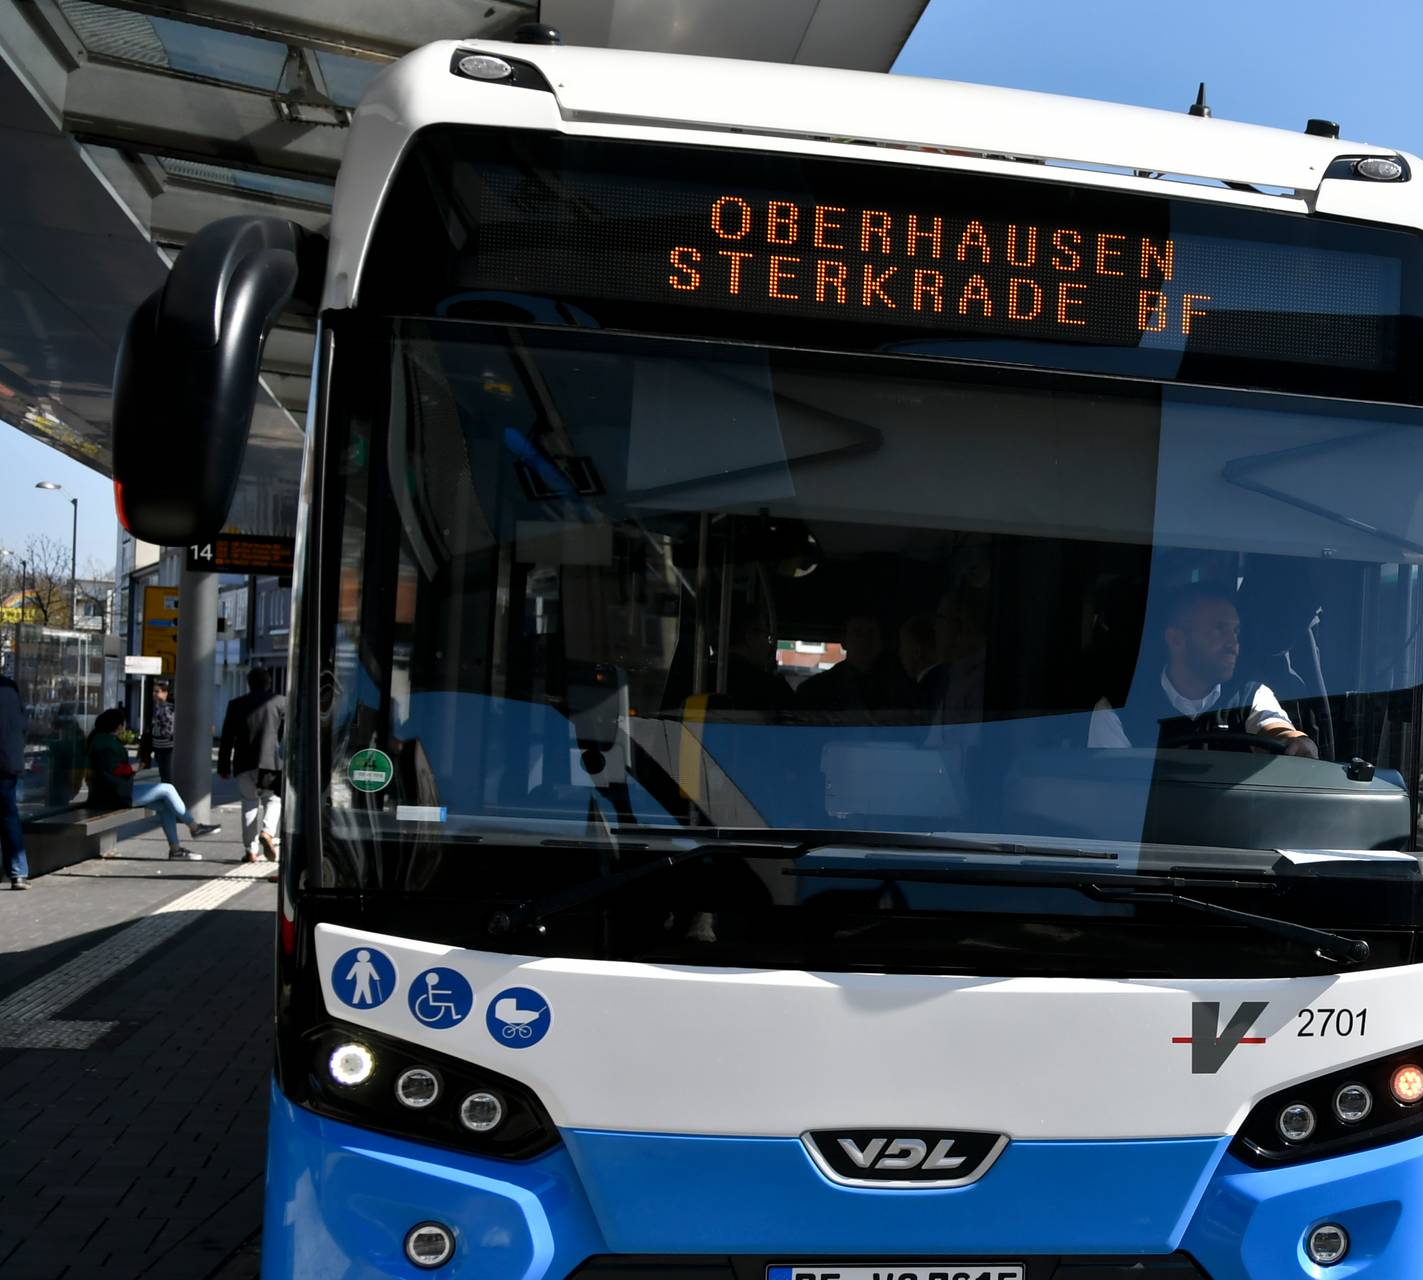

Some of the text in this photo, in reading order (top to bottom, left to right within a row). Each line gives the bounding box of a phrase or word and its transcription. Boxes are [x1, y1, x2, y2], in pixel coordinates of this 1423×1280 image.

[710, 195, 1175, 282] OBERHAUSEN
[667, 246, 1212, 336] STERKRADE BF
[189, 543, 213, 561] 14
[1297, 1007, 1367, 1037] 2701
[836, 1138, 968, 1170] VDL
